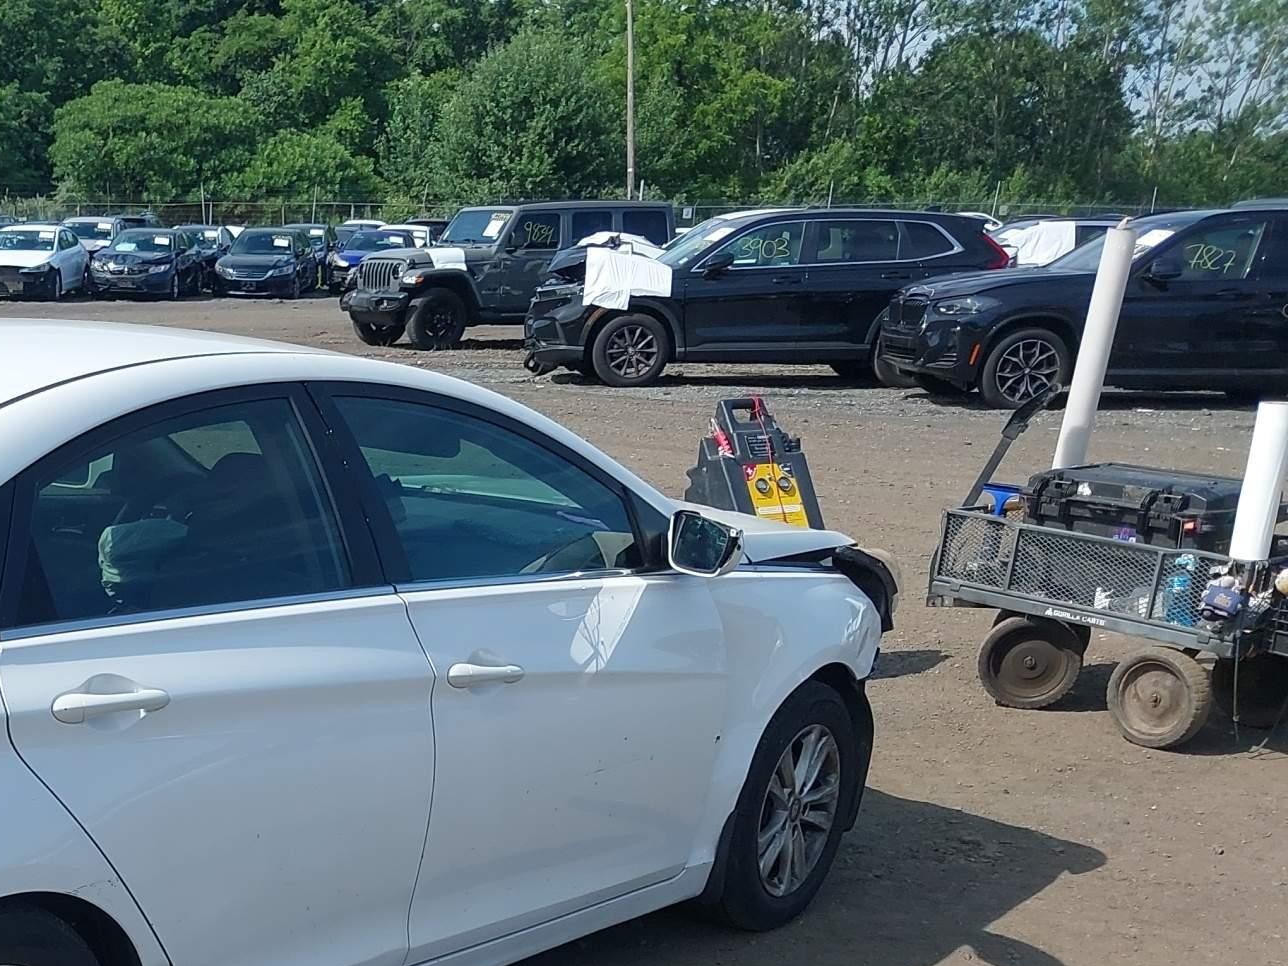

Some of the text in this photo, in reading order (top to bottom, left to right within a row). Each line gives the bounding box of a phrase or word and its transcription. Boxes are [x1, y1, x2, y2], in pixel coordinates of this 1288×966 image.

[737, 237, 790, 260] 3903
[1185, 243, 1236, 274] 7827
[1053, 609, 1081, 620] GORILLA
